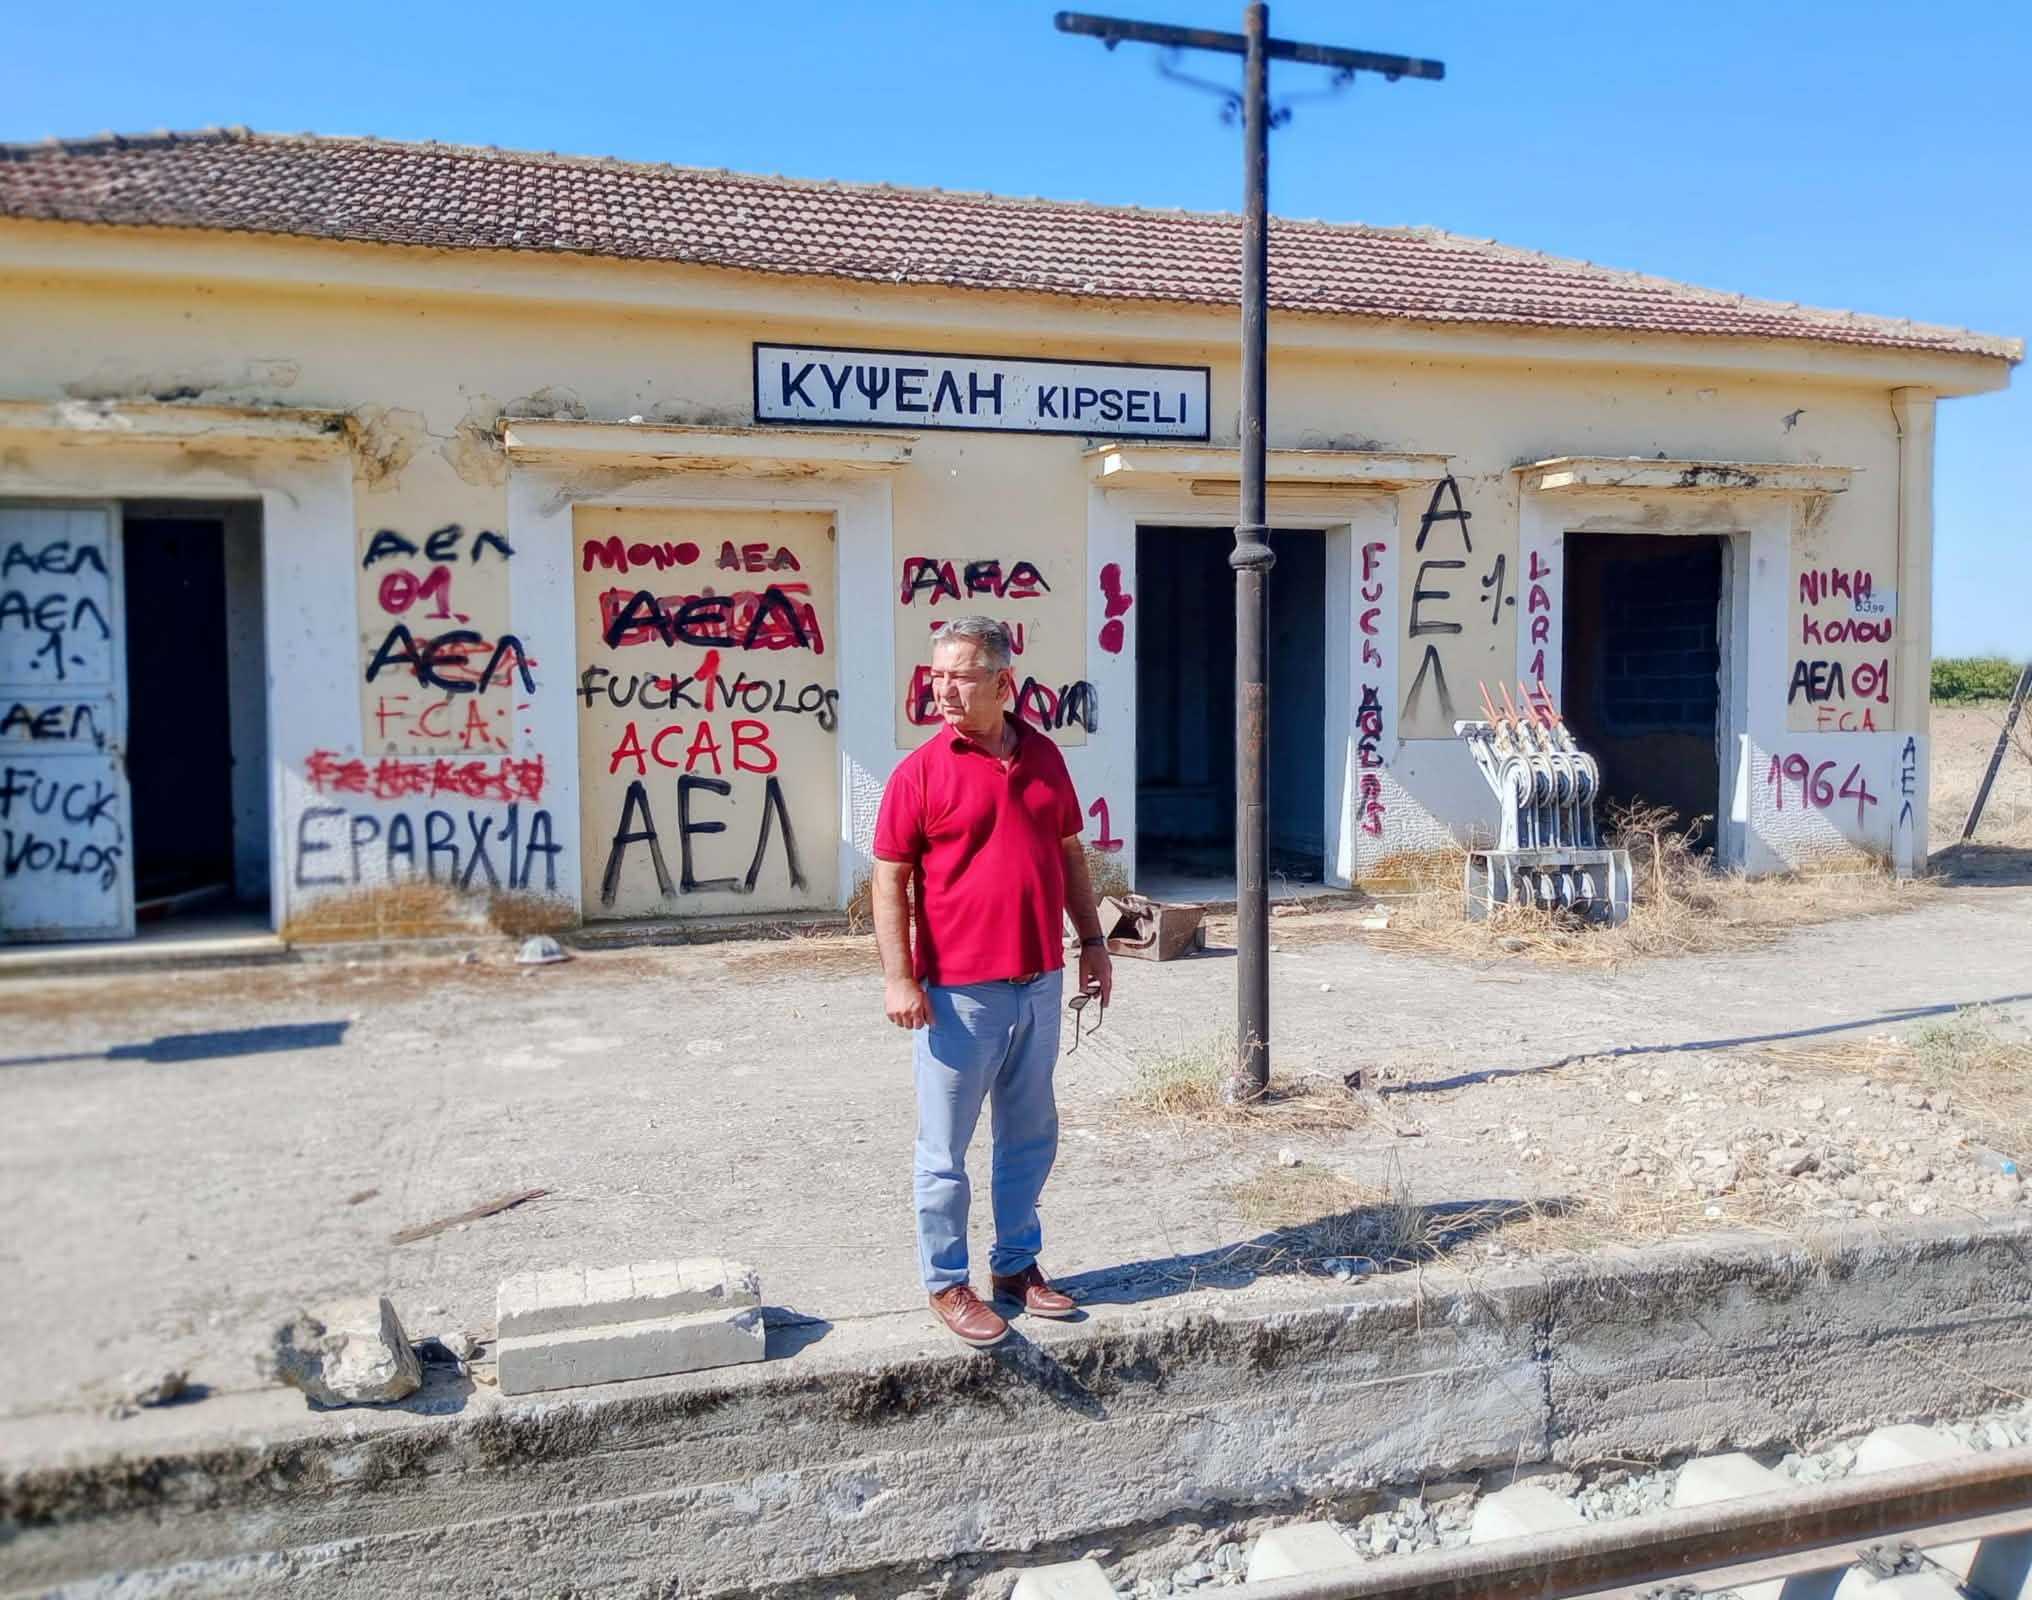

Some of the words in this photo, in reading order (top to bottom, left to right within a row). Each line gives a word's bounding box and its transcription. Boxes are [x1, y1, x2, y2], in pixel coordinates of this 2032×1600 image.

[781, 361, 1005, 416] ΚΥΨΕΛΗ
[1037, 385, 1188, 425] KIPSELI
[608, 719, 779, 776] ACAB
[1767, 752, 1879, 830] 1964
